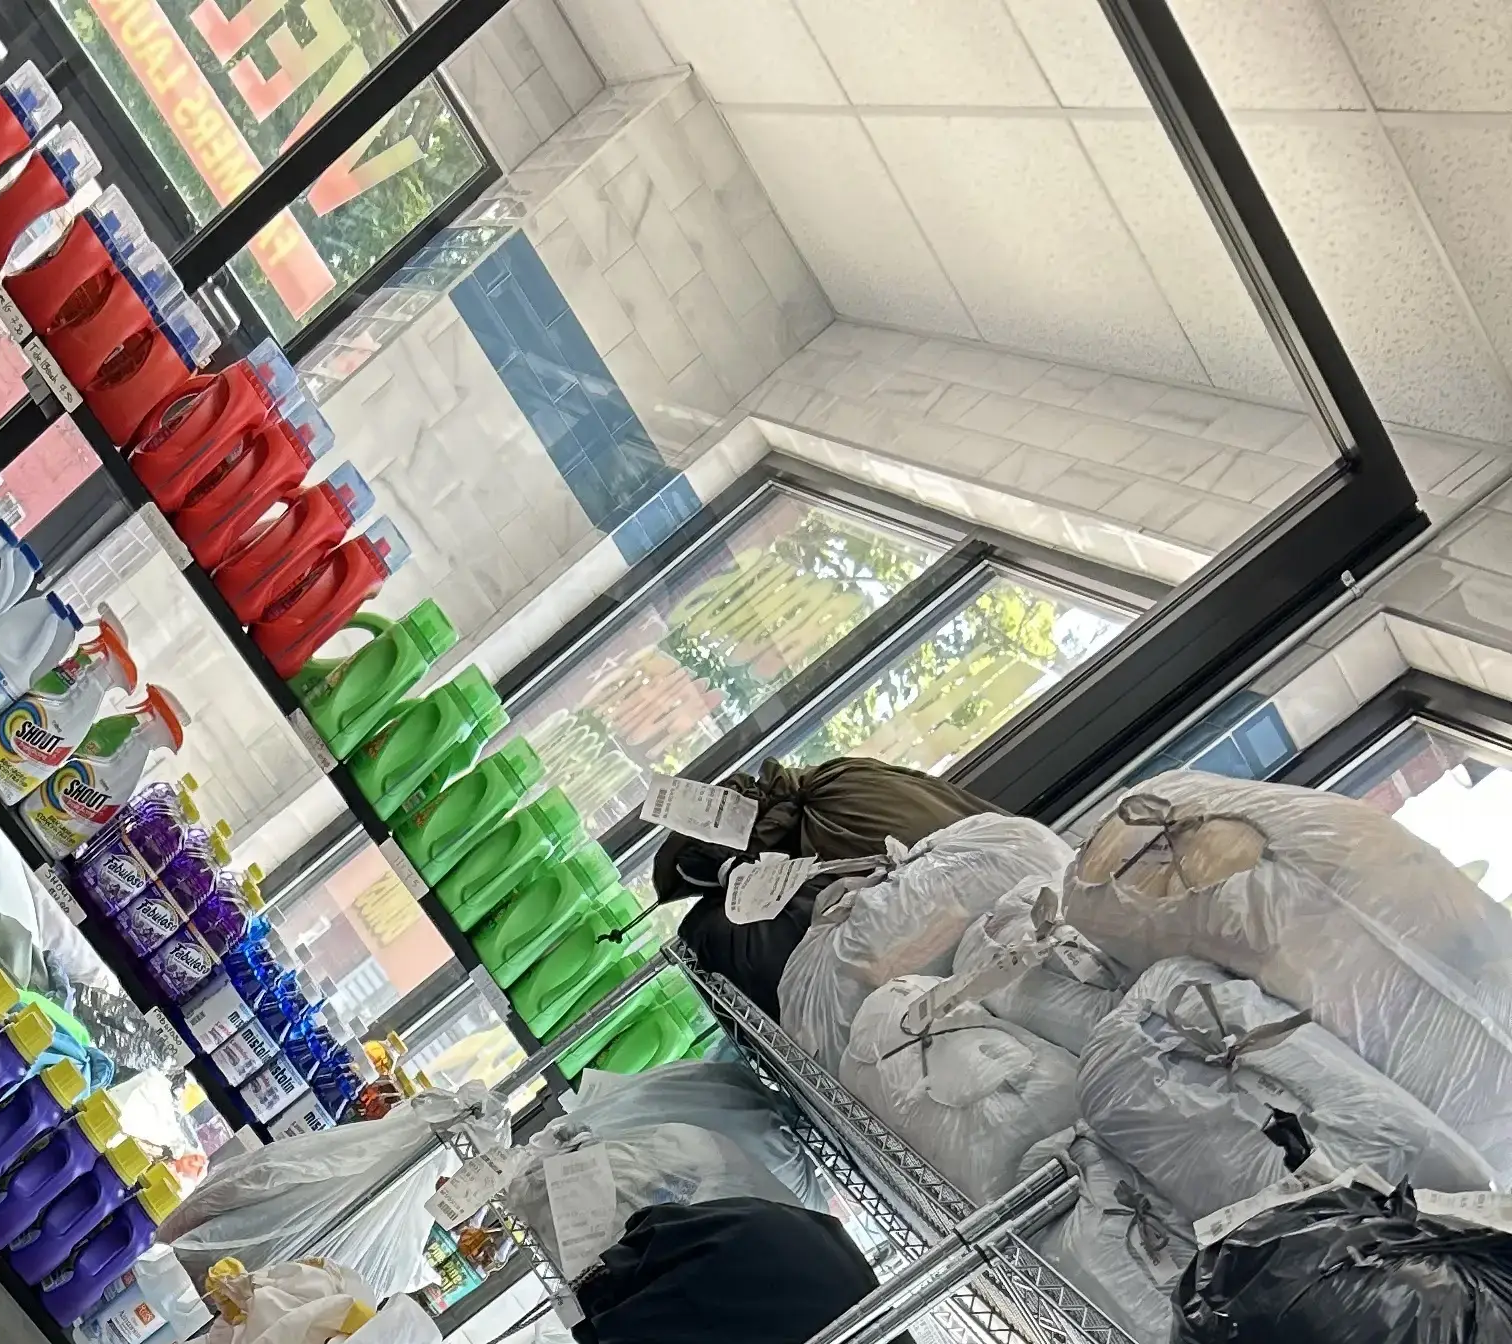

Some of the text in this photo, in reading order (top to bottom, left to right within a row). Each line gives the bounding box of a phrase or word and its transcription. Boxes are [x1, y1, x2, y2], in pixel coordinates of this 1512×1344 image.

[14, 718, 63, 754] SHOUT
[62, 778, 112, 813] SHOUT
[42, 867, 77, 908] SHOUT
[102, 854, 146, 891] Fabuloso
[135, 898, 179, 934] Fabuloso
[169, 941, 212, 977] Fabuloso
[440, 1259, 465, 1285] Pine
